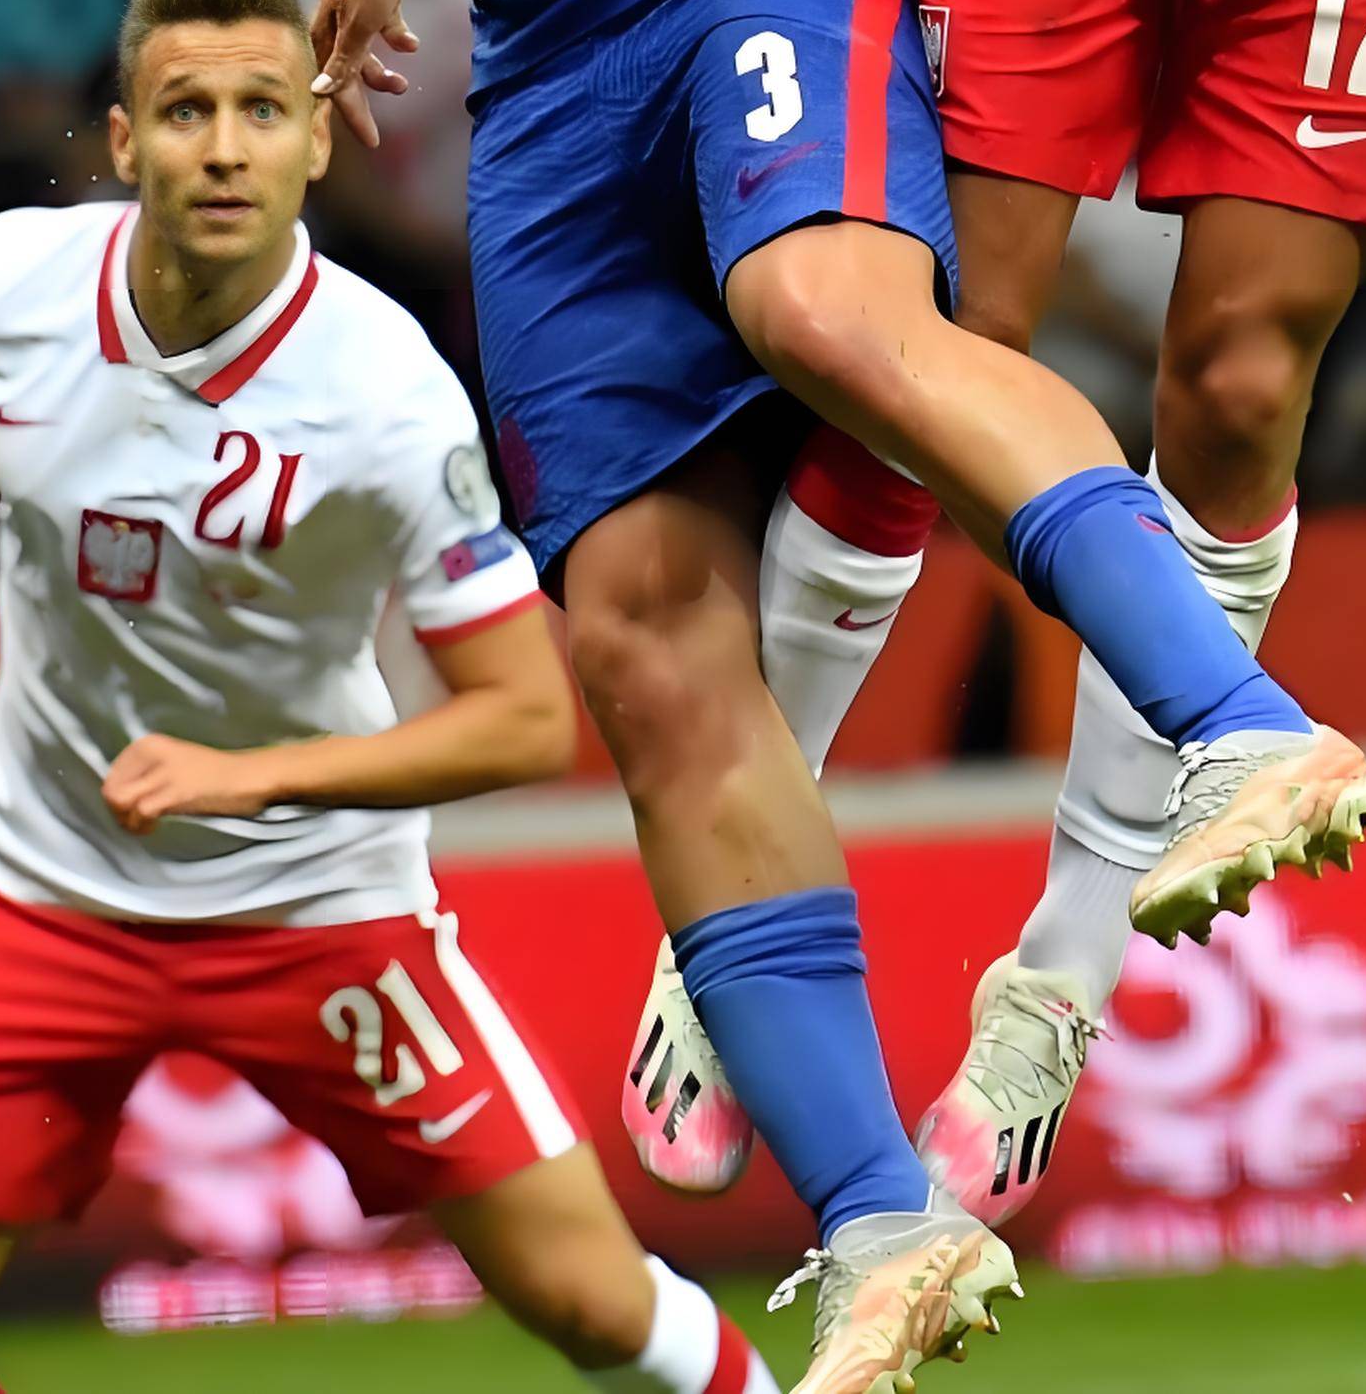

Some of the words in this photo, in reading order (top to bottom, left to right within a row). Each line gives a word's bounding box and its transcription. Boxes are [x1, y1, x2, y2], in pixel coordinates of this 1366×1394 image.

[735, 31, 803, 142] 3
[194, 430, 305, 551] 21
[319, 958, 464, 1107] 21
